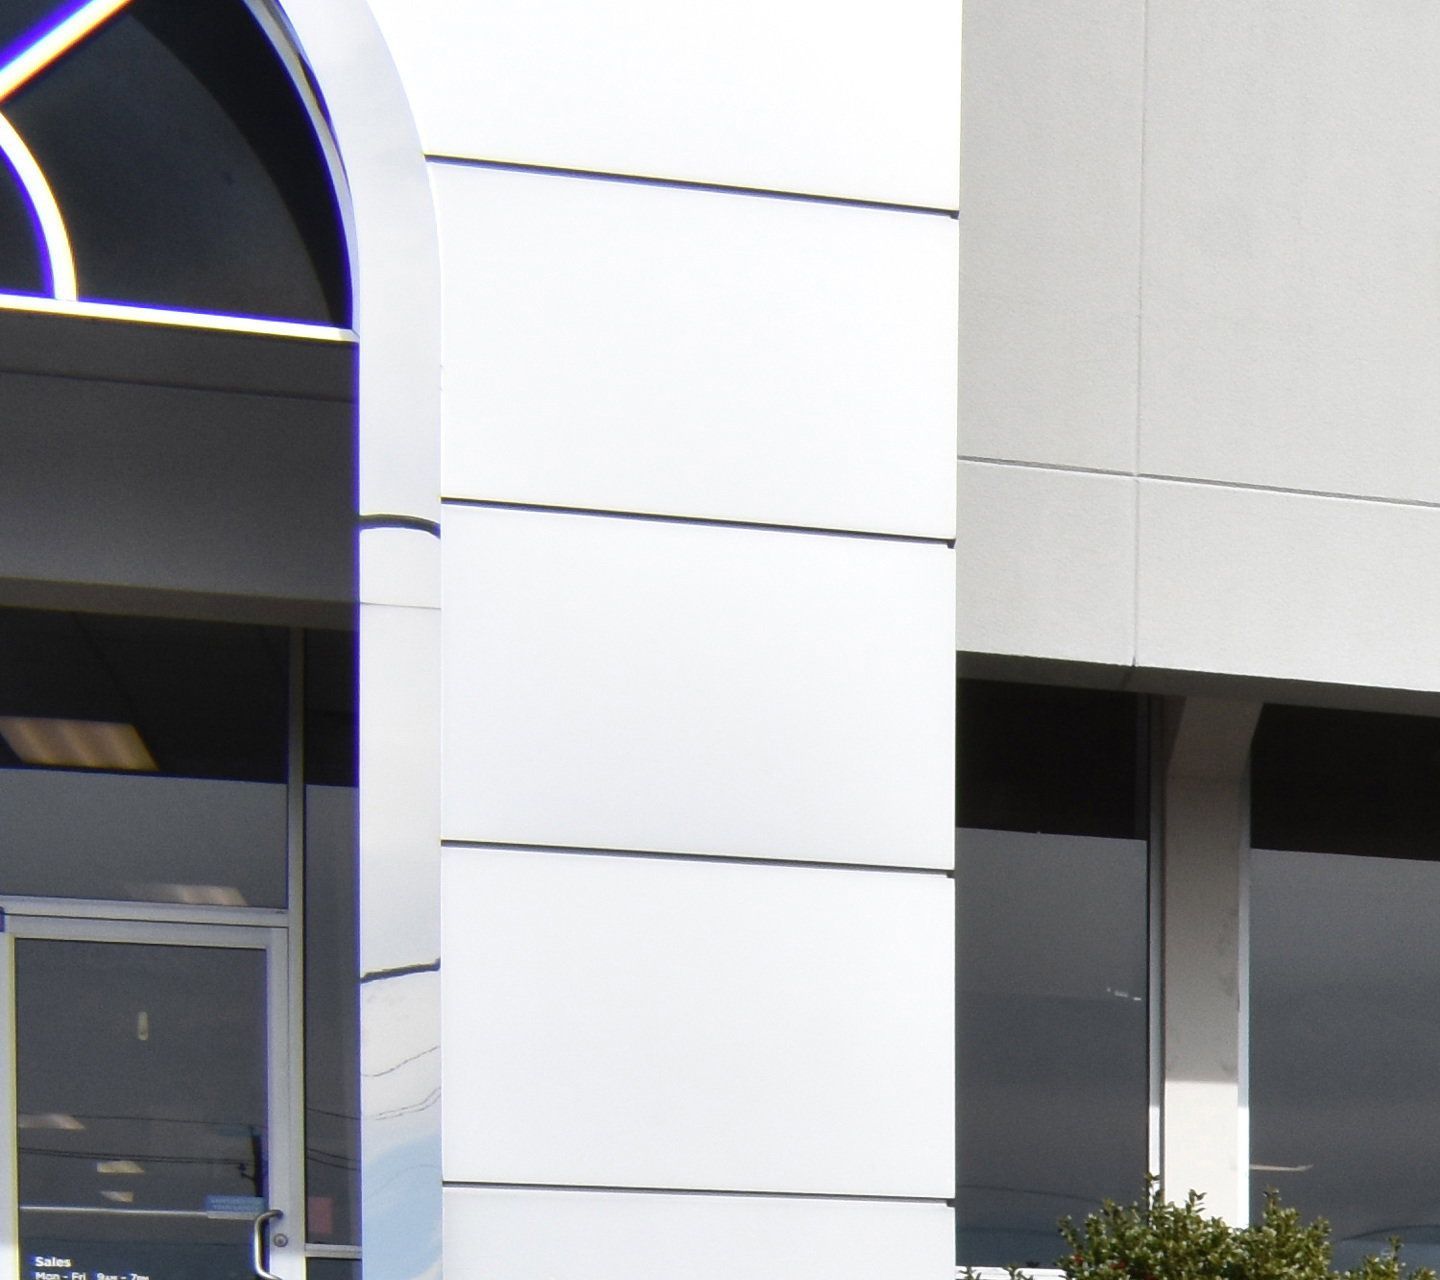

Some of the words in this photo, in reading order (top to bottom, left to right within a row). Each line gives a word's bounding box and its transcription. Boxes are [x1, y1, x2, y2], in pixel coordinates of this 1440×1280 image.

[34, 1256, 72, 1268] Sales
[34, 1272, 60, 1280] Mon
[71, 1272, 87, 1280] Fri
